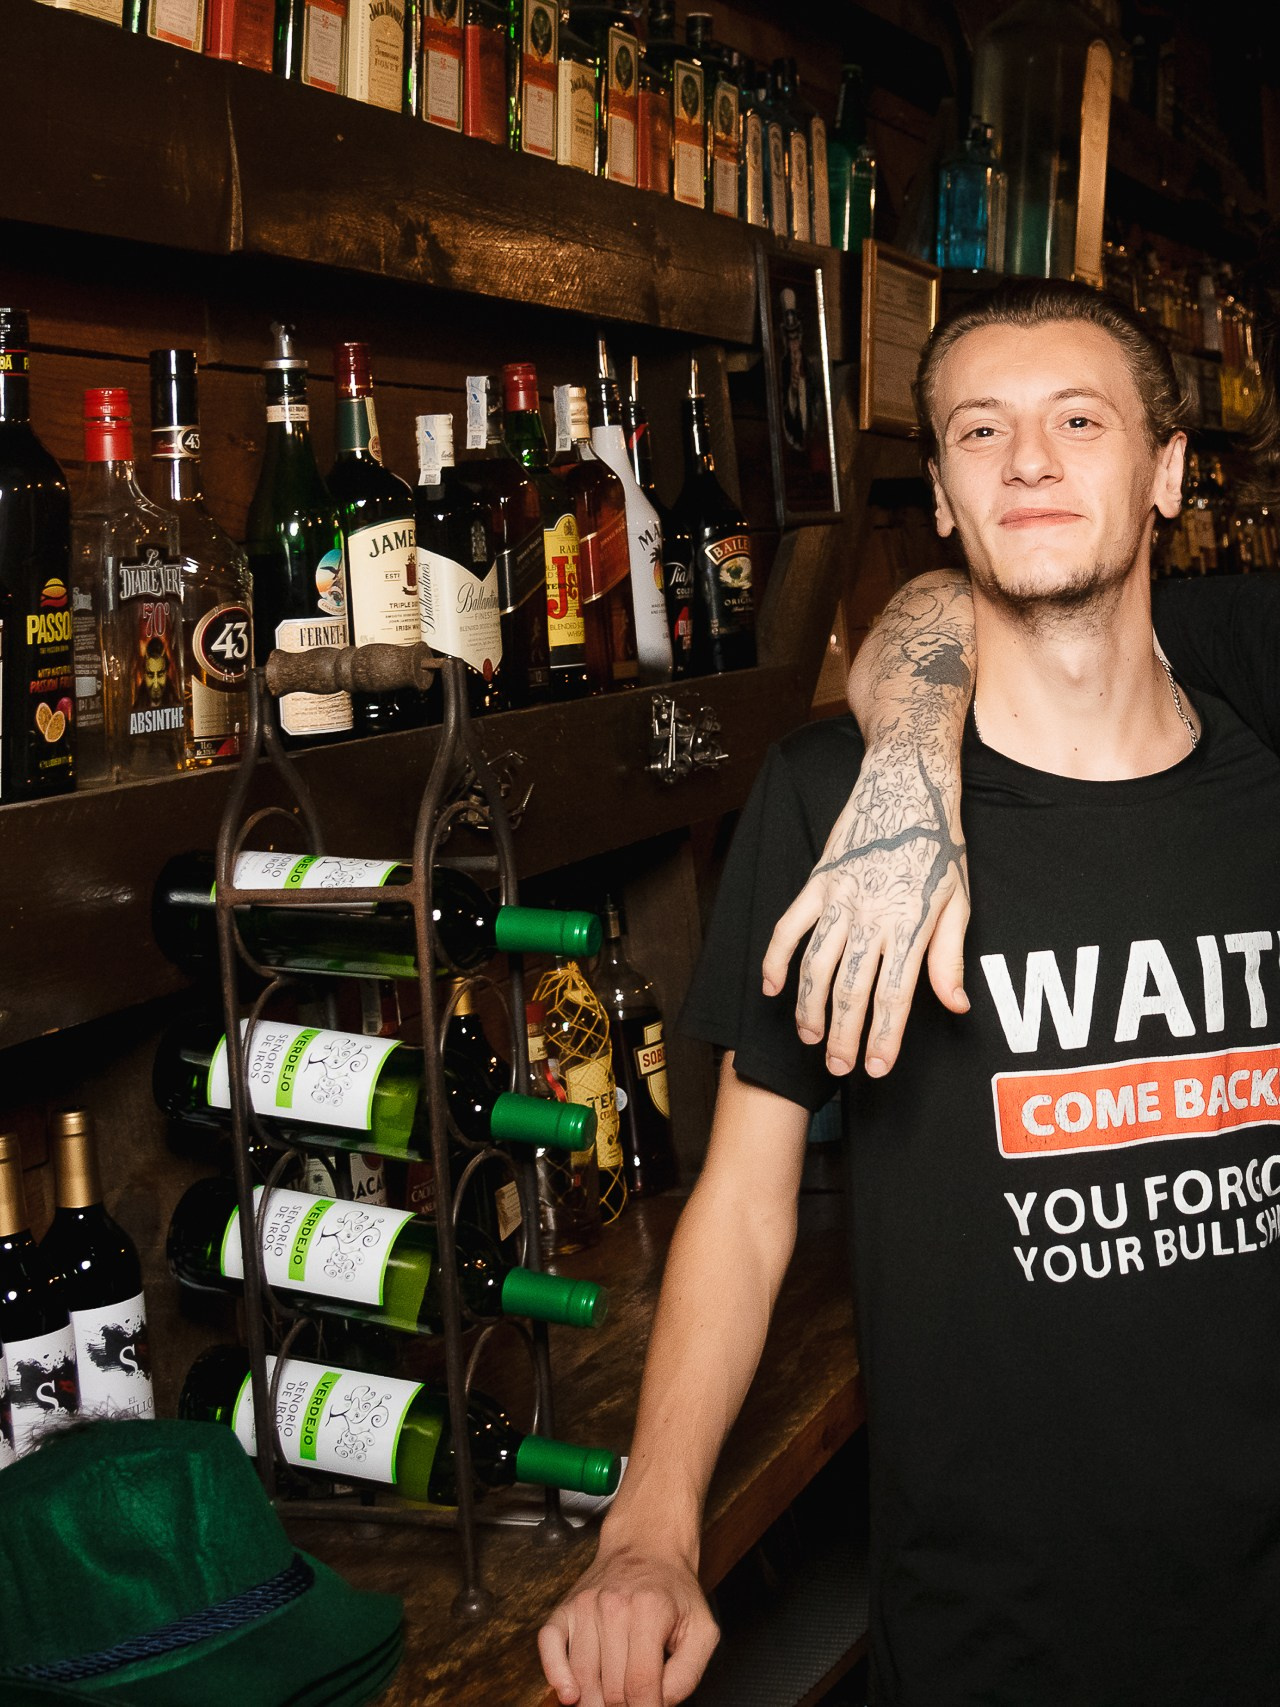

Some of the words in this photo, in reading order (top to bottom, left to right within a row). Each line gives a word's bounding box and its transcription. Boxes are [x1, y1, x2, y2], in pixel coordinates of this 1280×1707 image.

[184, 433, 200, 449] 43
[712, 538, 750, 559] BAILE
[119, 568, 162, 601] DIABLE
[27, 611, 73, 645] PASSO
[209, 621, 248, 660] 43
[300, 625, 348, 648] FERNET-
[129, 706, 184, 735] ABSINTHE
[290, 856, 315, 883] DEJO
[261, 1034, 276, 1047] DE
[251, 1050, 267, 1079] IROS
[280, 1034, 313, 1092] VERDEJO
[1020, 1080, 1162, 1137] COME
[274, 1206, 290, 1219] DE
[1003, 1182, 1128, 1236] YOU
[264, 1222, 280, 1251] IROS
[293, 1206, 326, 1265] VERDEJO
[1013, 1236, 1145, 1283] YOUR
[118, 1343, 139, 1373] S
[36, 1380, 60, 1410] S
[128, 1396, 138, 1405] EL
[281, 1382, 296, 1398] DE
[303, 1381, 332, 1446] VERDEJO
